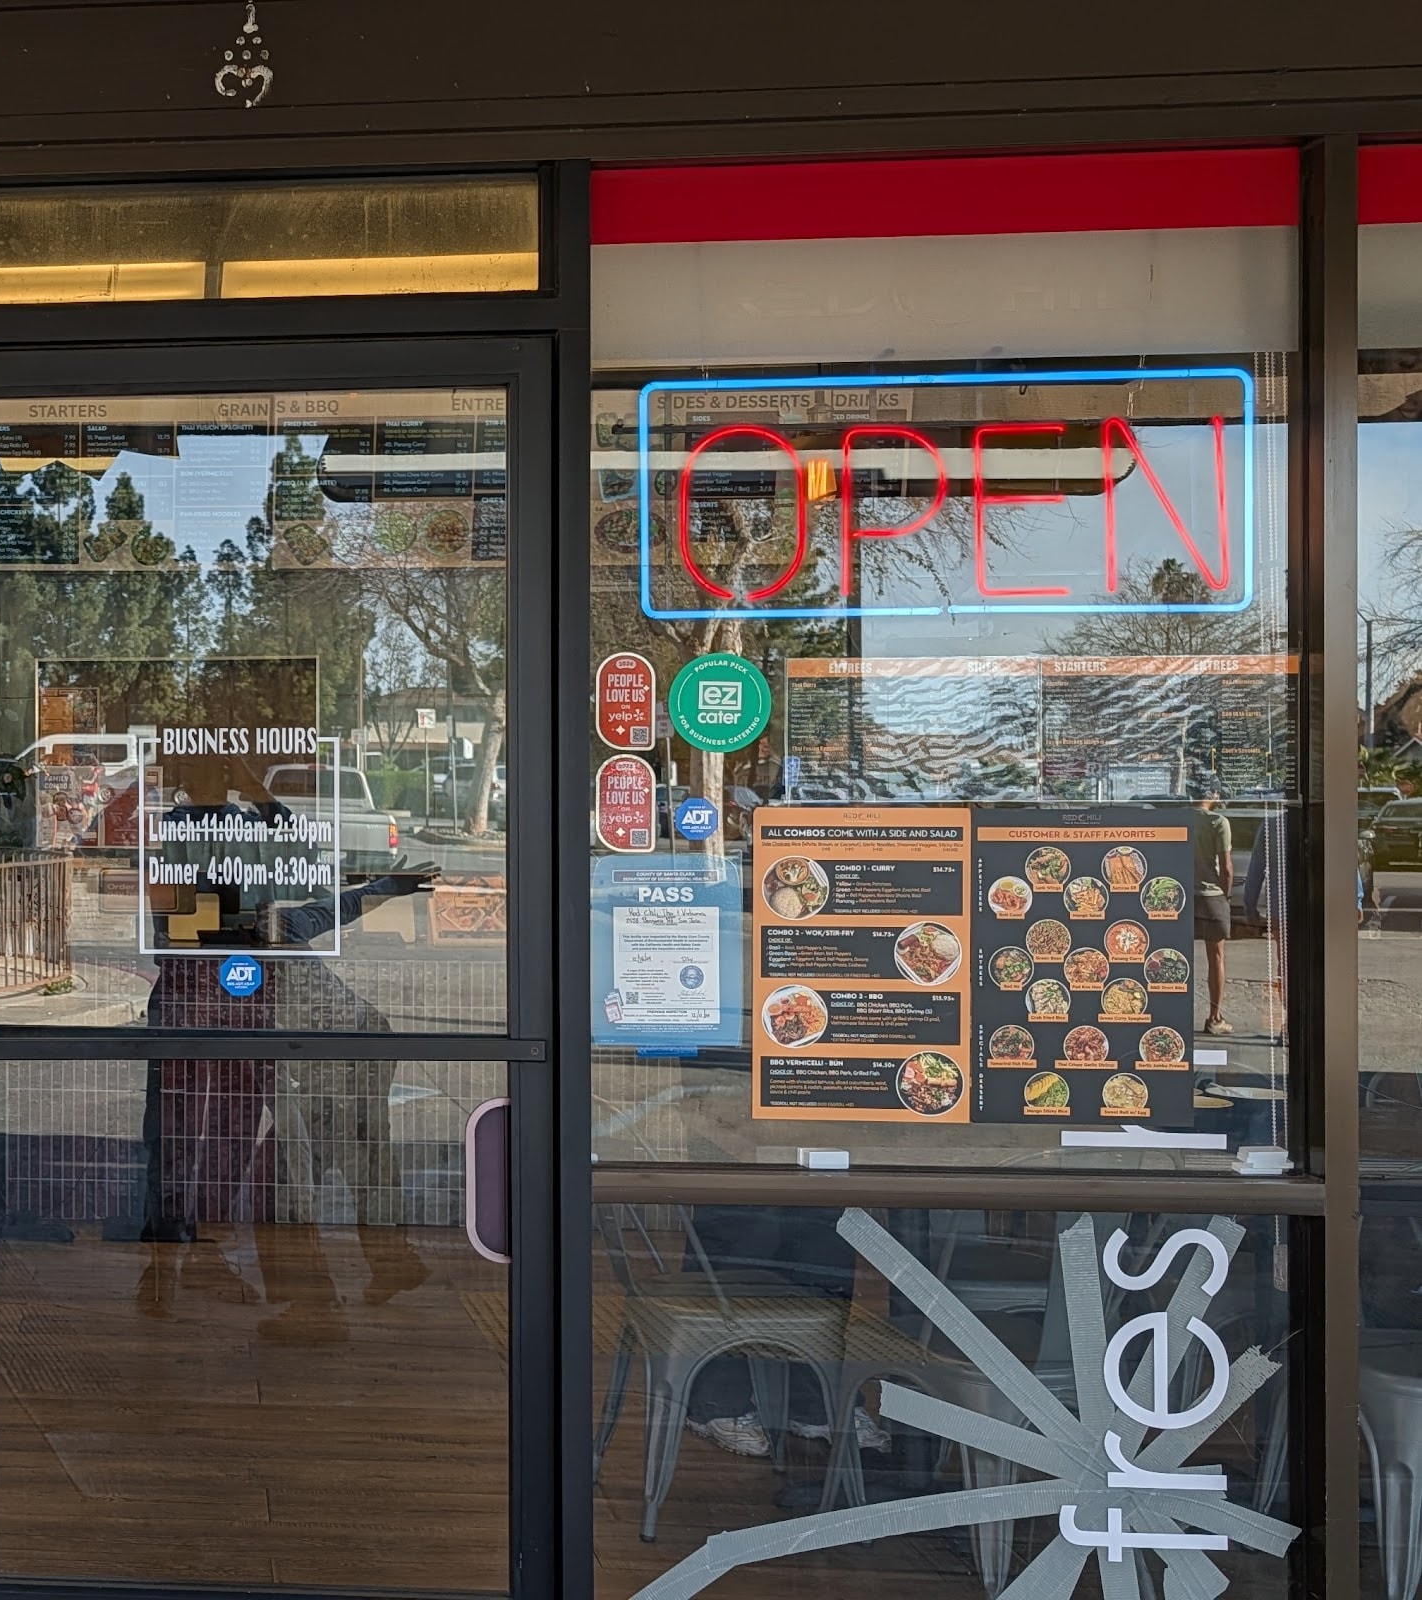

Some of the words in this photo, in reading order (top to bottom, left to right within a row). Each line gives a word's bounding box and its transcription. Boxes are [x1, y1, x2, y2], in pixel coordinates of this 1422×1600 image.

[290, 401, 300, 413] &
[305, 400, 339, 413] BBQ
[710, 397, 720, 408] &
[731, 395, 810, 408] DESSERTS
[29, 405, 107, 417] STARTERS
[680, 415, 1231, 601] OPEN
[695, 660, 728, 672] POPULAR
[730, 661, 748, 674] PICK
[1054, 661, 1106, 672] STARTERS
[1194, 660, 1239, 670] ENTREES
[608, 674, 644, 687] PEOPLE
[606, 689, 630, 702] LOVE
[632, 689, 645, 702] US
[704, 687, 737, 705] ez
[608, 710, 633, 722] yelp
[697, 710, 741, 724] cater
[679, 715, 690, 730] FOR
[689, 728, 726, 745] BUSINESS
[728, 716, 760, 744] CATERING
[163, 728, 249, 755] BUSINESS
[256, 727, 316, 755] HOURS
[608, 776, 644, 789] PEOPLE
[606, 791, 630, 805] LOVE
[632, 791, 645, 805] US
[609, 811, 633, 824] yelp
[681, 810, 713, 824] ADT
[768, 830, 782, 838] ALL
[784, 830, 825, 838] COMBOS
[828, 830, 854, 838] COME
[855, 830, 878, 838] WITH
[880, 830, 886, 838] A
[889, 830, 906, 838] SIDE
[909, 830, 928, 838] AND
[930, 830, 957, 838] SALAD
[1009, 830, 1060, 839] CUSTOMER
[1063, 830, 1069, 839] &
[1072, 830, 1100, 839] STAFF
[1104, 830, 1155, 839] FAVORITES
[149, 857, 199, 884] Dinner
[207, 856, 331, 892] 4:00pm-8:30pm
[638, 887, 694, 902] PASS
[226, 967, 256, 982] ADT
[770, 1059, 785, 1067] BBQ
[786, 1059, 823, 1067] VERMICELLI
